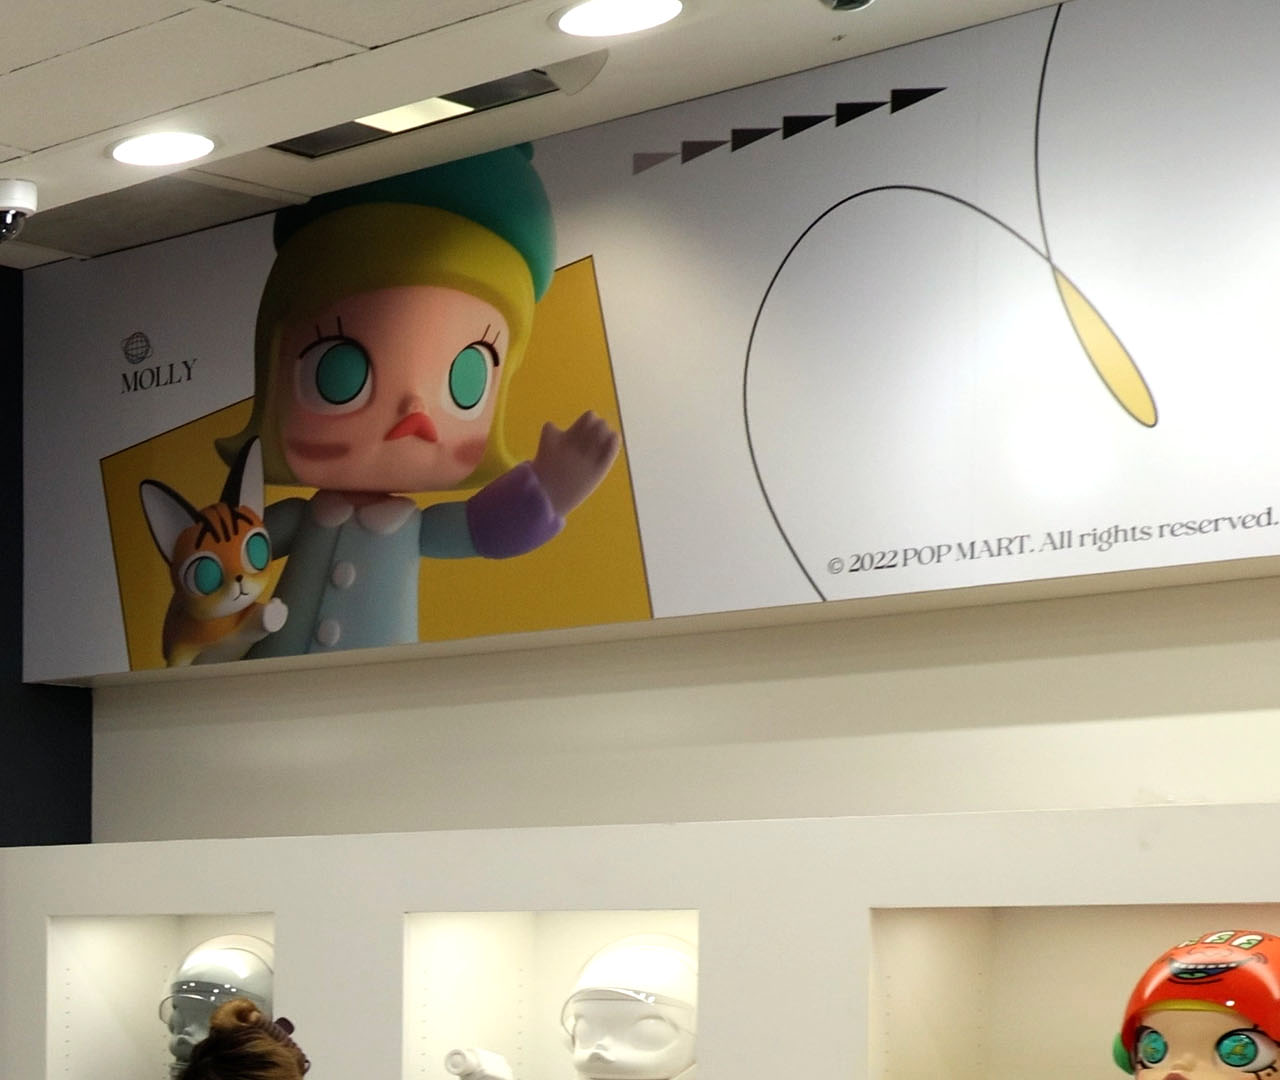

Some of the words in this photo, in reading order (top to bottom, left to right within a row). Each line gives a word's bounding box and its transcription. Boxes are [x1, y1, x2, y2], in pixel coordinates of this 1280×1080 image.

[121, 358, 197, 394] MOLLY
[848, 550, 898, 573] 2022
[902, 544, 952, 567] POP
[955, 534, 1034, 562] MART.
[1039, 530, 1073, 552] All
[1078, 525, 1153, 551] rights
[1157, 507, 1279, 538] reserved.
